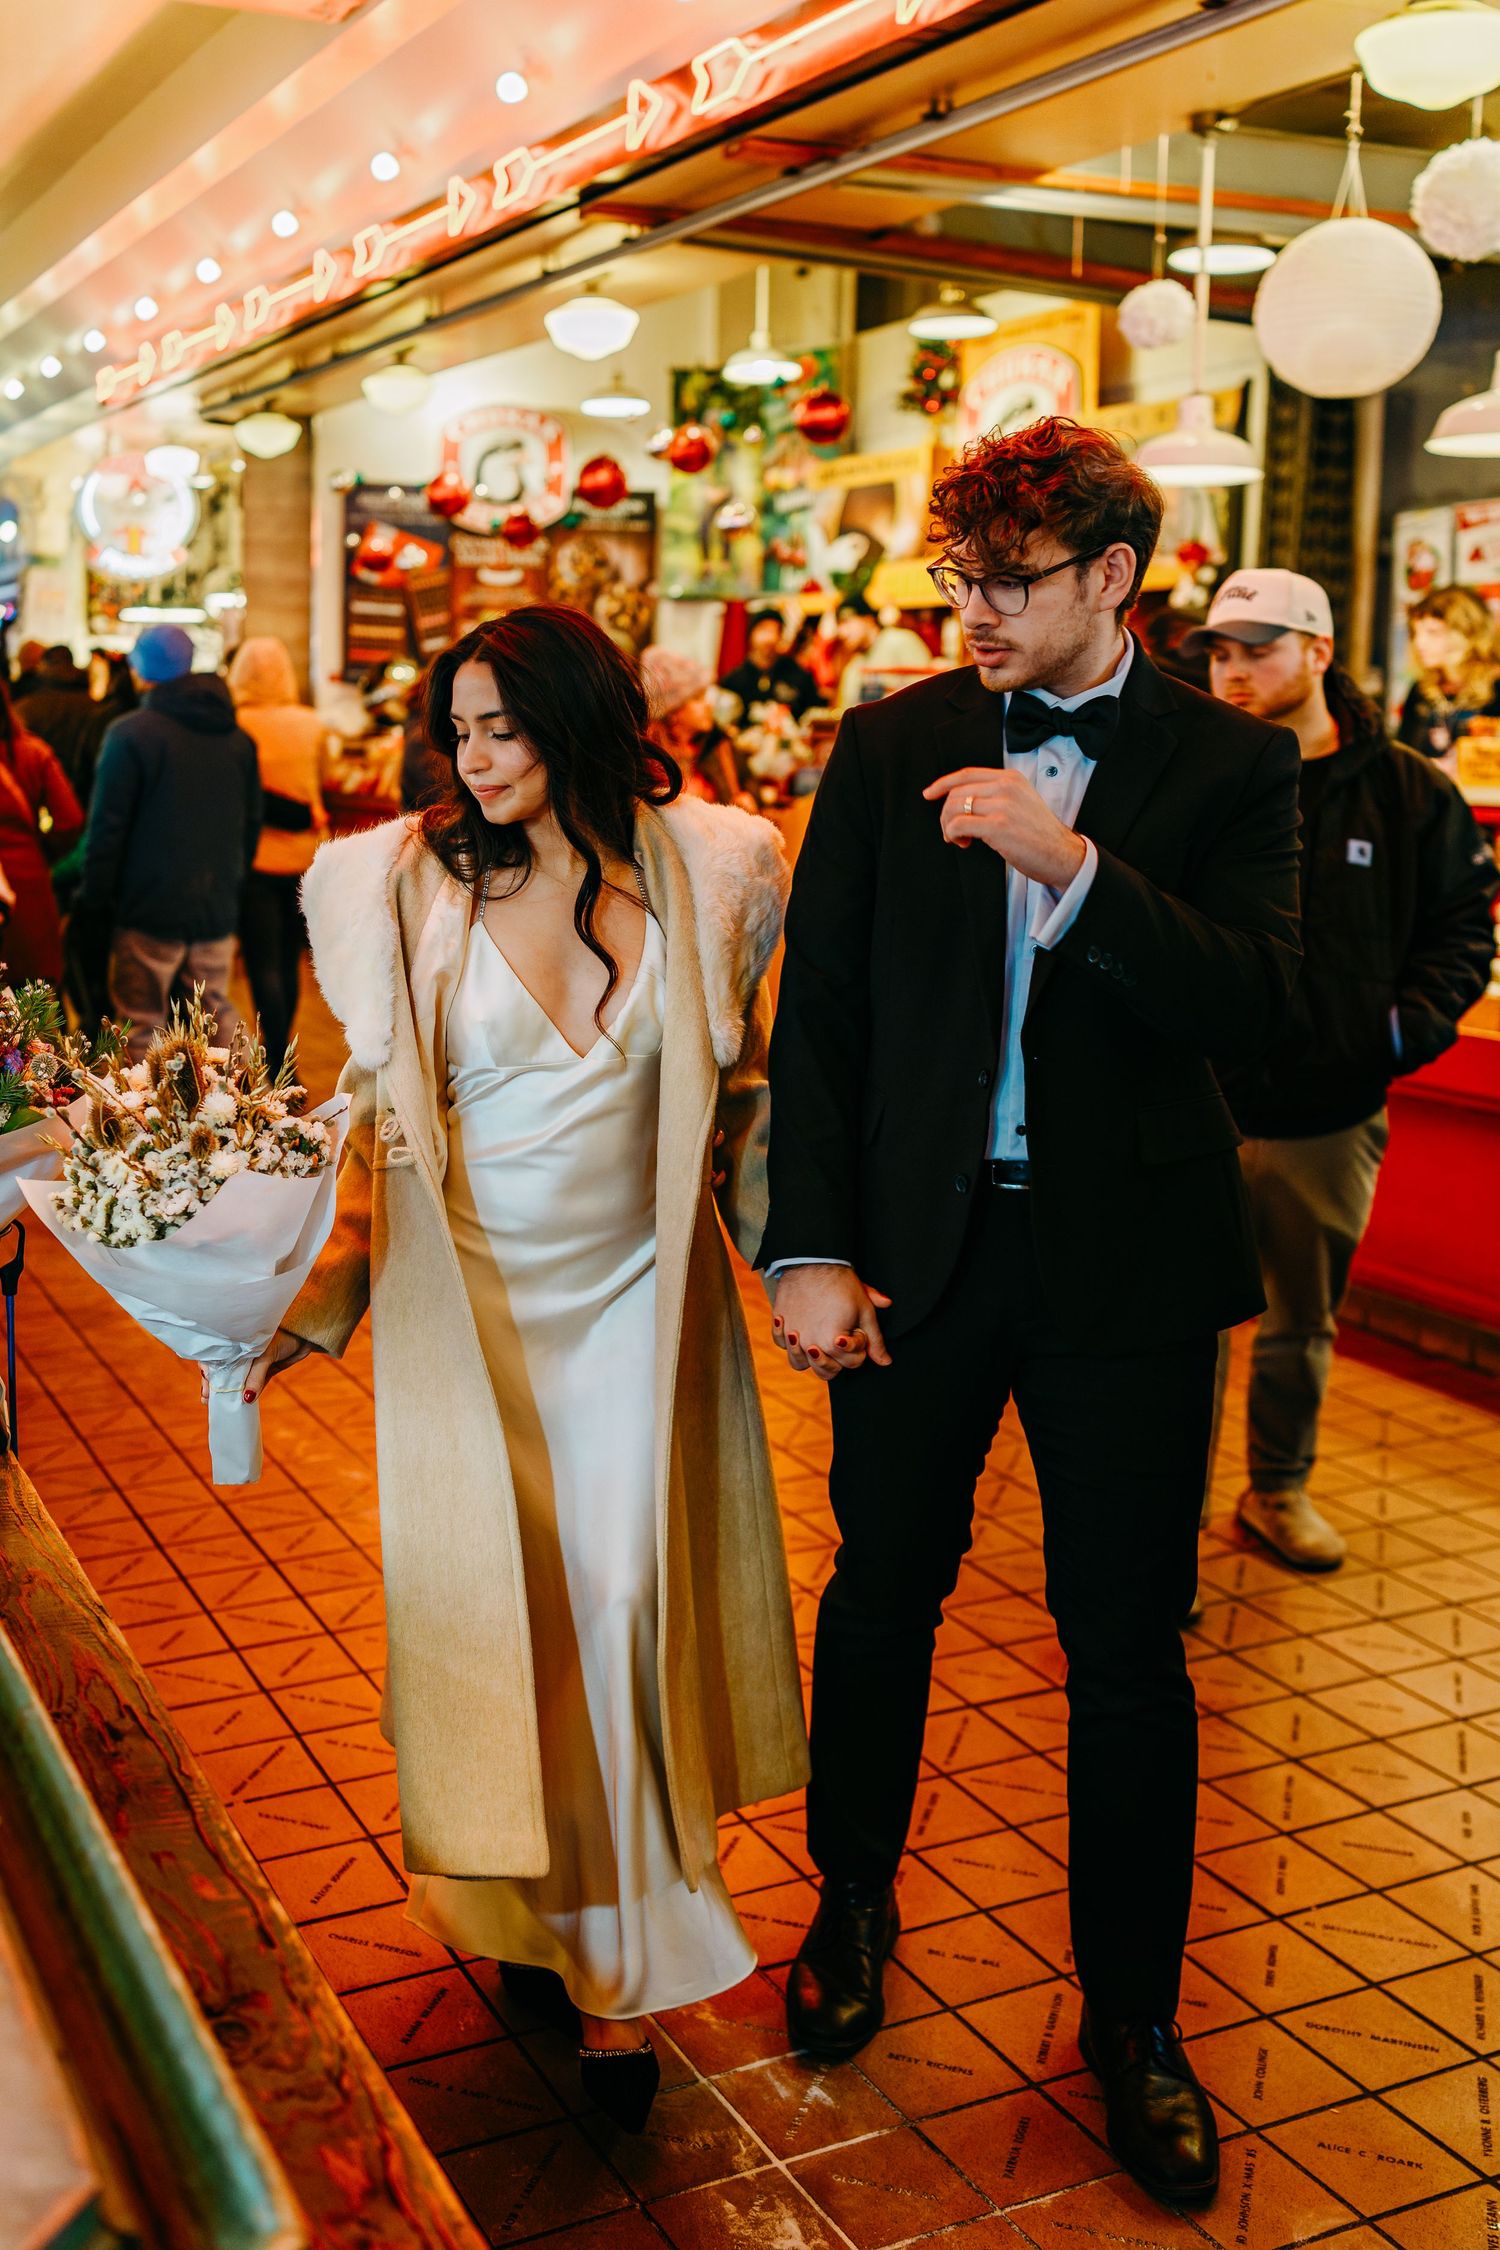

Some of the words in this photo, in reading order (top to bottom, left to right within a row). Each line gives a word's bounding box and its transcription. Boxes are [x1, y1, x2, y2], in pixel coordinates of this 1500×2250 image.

[374, 1943, 421, 1959] PETERSON
[1304, 2021, 1362, 2038] DOROTHY
[887, 2052, 920, 2066] BETSY
[926, 2060, 974, 2077] RICHENS
[408, 2075, 440, 2090] NORA
[1252, 2077, 1265, 2101] JOHN
[1482, 2126, 1493, 2157] YVONNE
[1002, 2147, 1023, 2179] PATRICIA
[1317, 2141, 1352, 2154] ALICE
[1359, 2148, 1369, 2159] C
[1377, 2154, 1425, 2170] ROARK
[1237, 2189, 1252, 2232] JOHNSON
[1486, 2200, 1499, 2231] LEEANN
